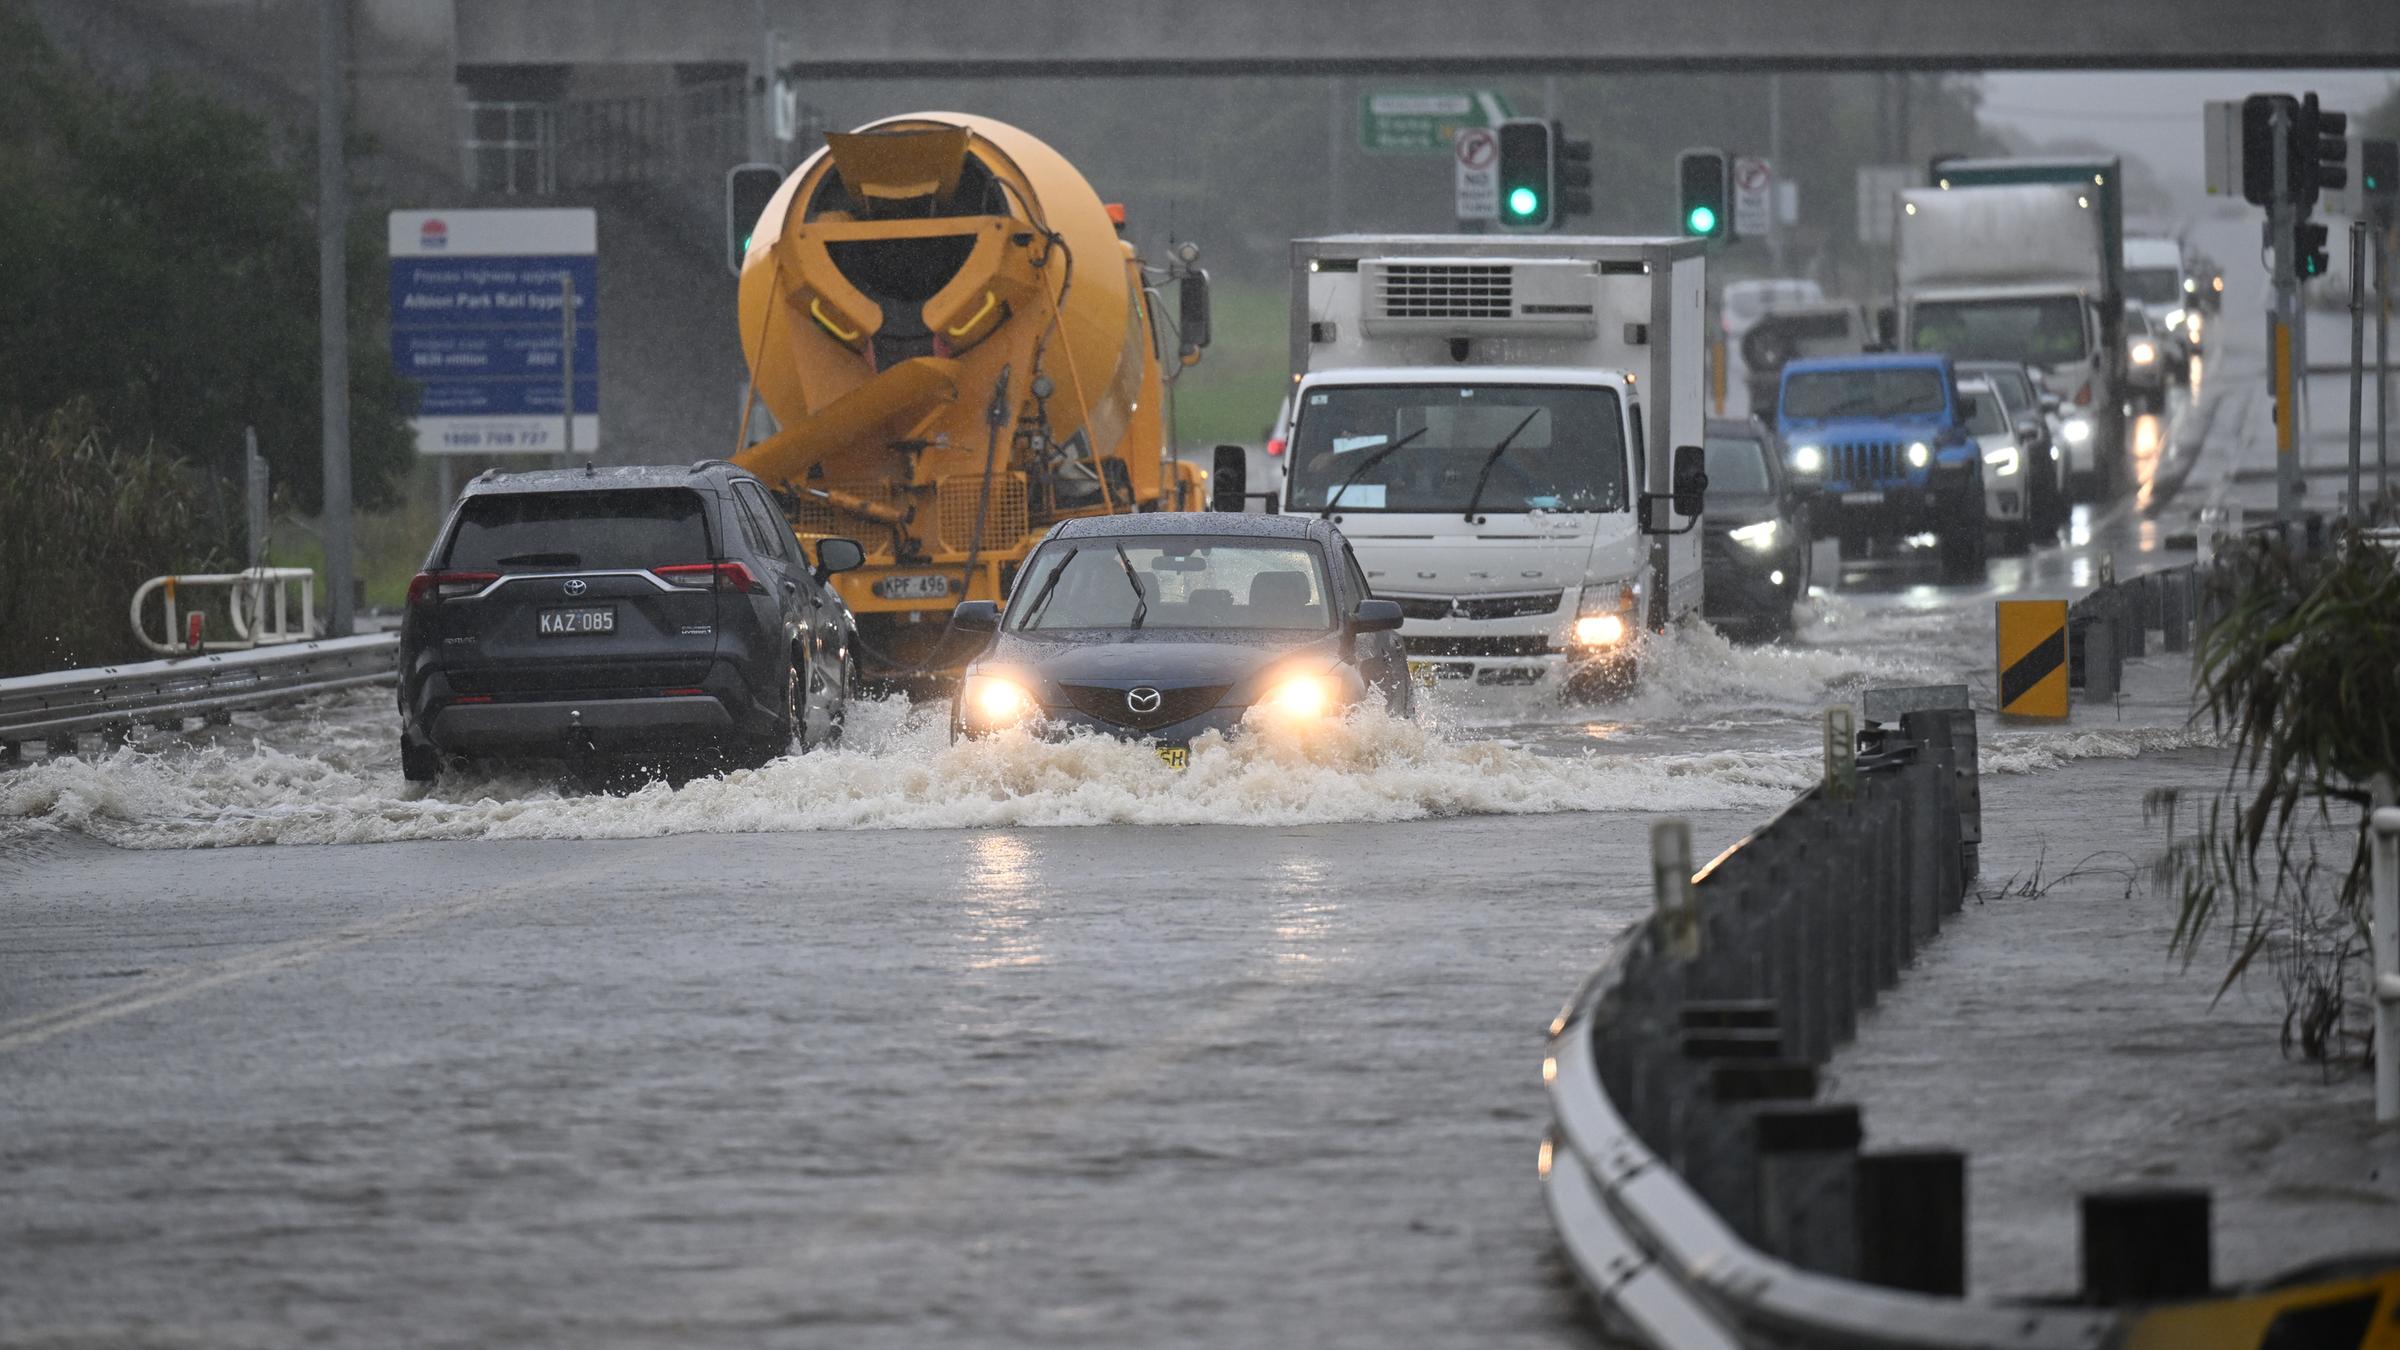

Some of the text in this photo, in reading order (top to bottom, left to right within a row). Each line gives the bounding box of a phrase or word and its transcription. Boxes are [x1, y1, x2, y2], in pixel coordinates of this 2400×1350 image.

[527, 292, 584, 310] bypas
[886, 577, 945, 593] KPF 496
[541, 612, 613, 632] KAZ 085
